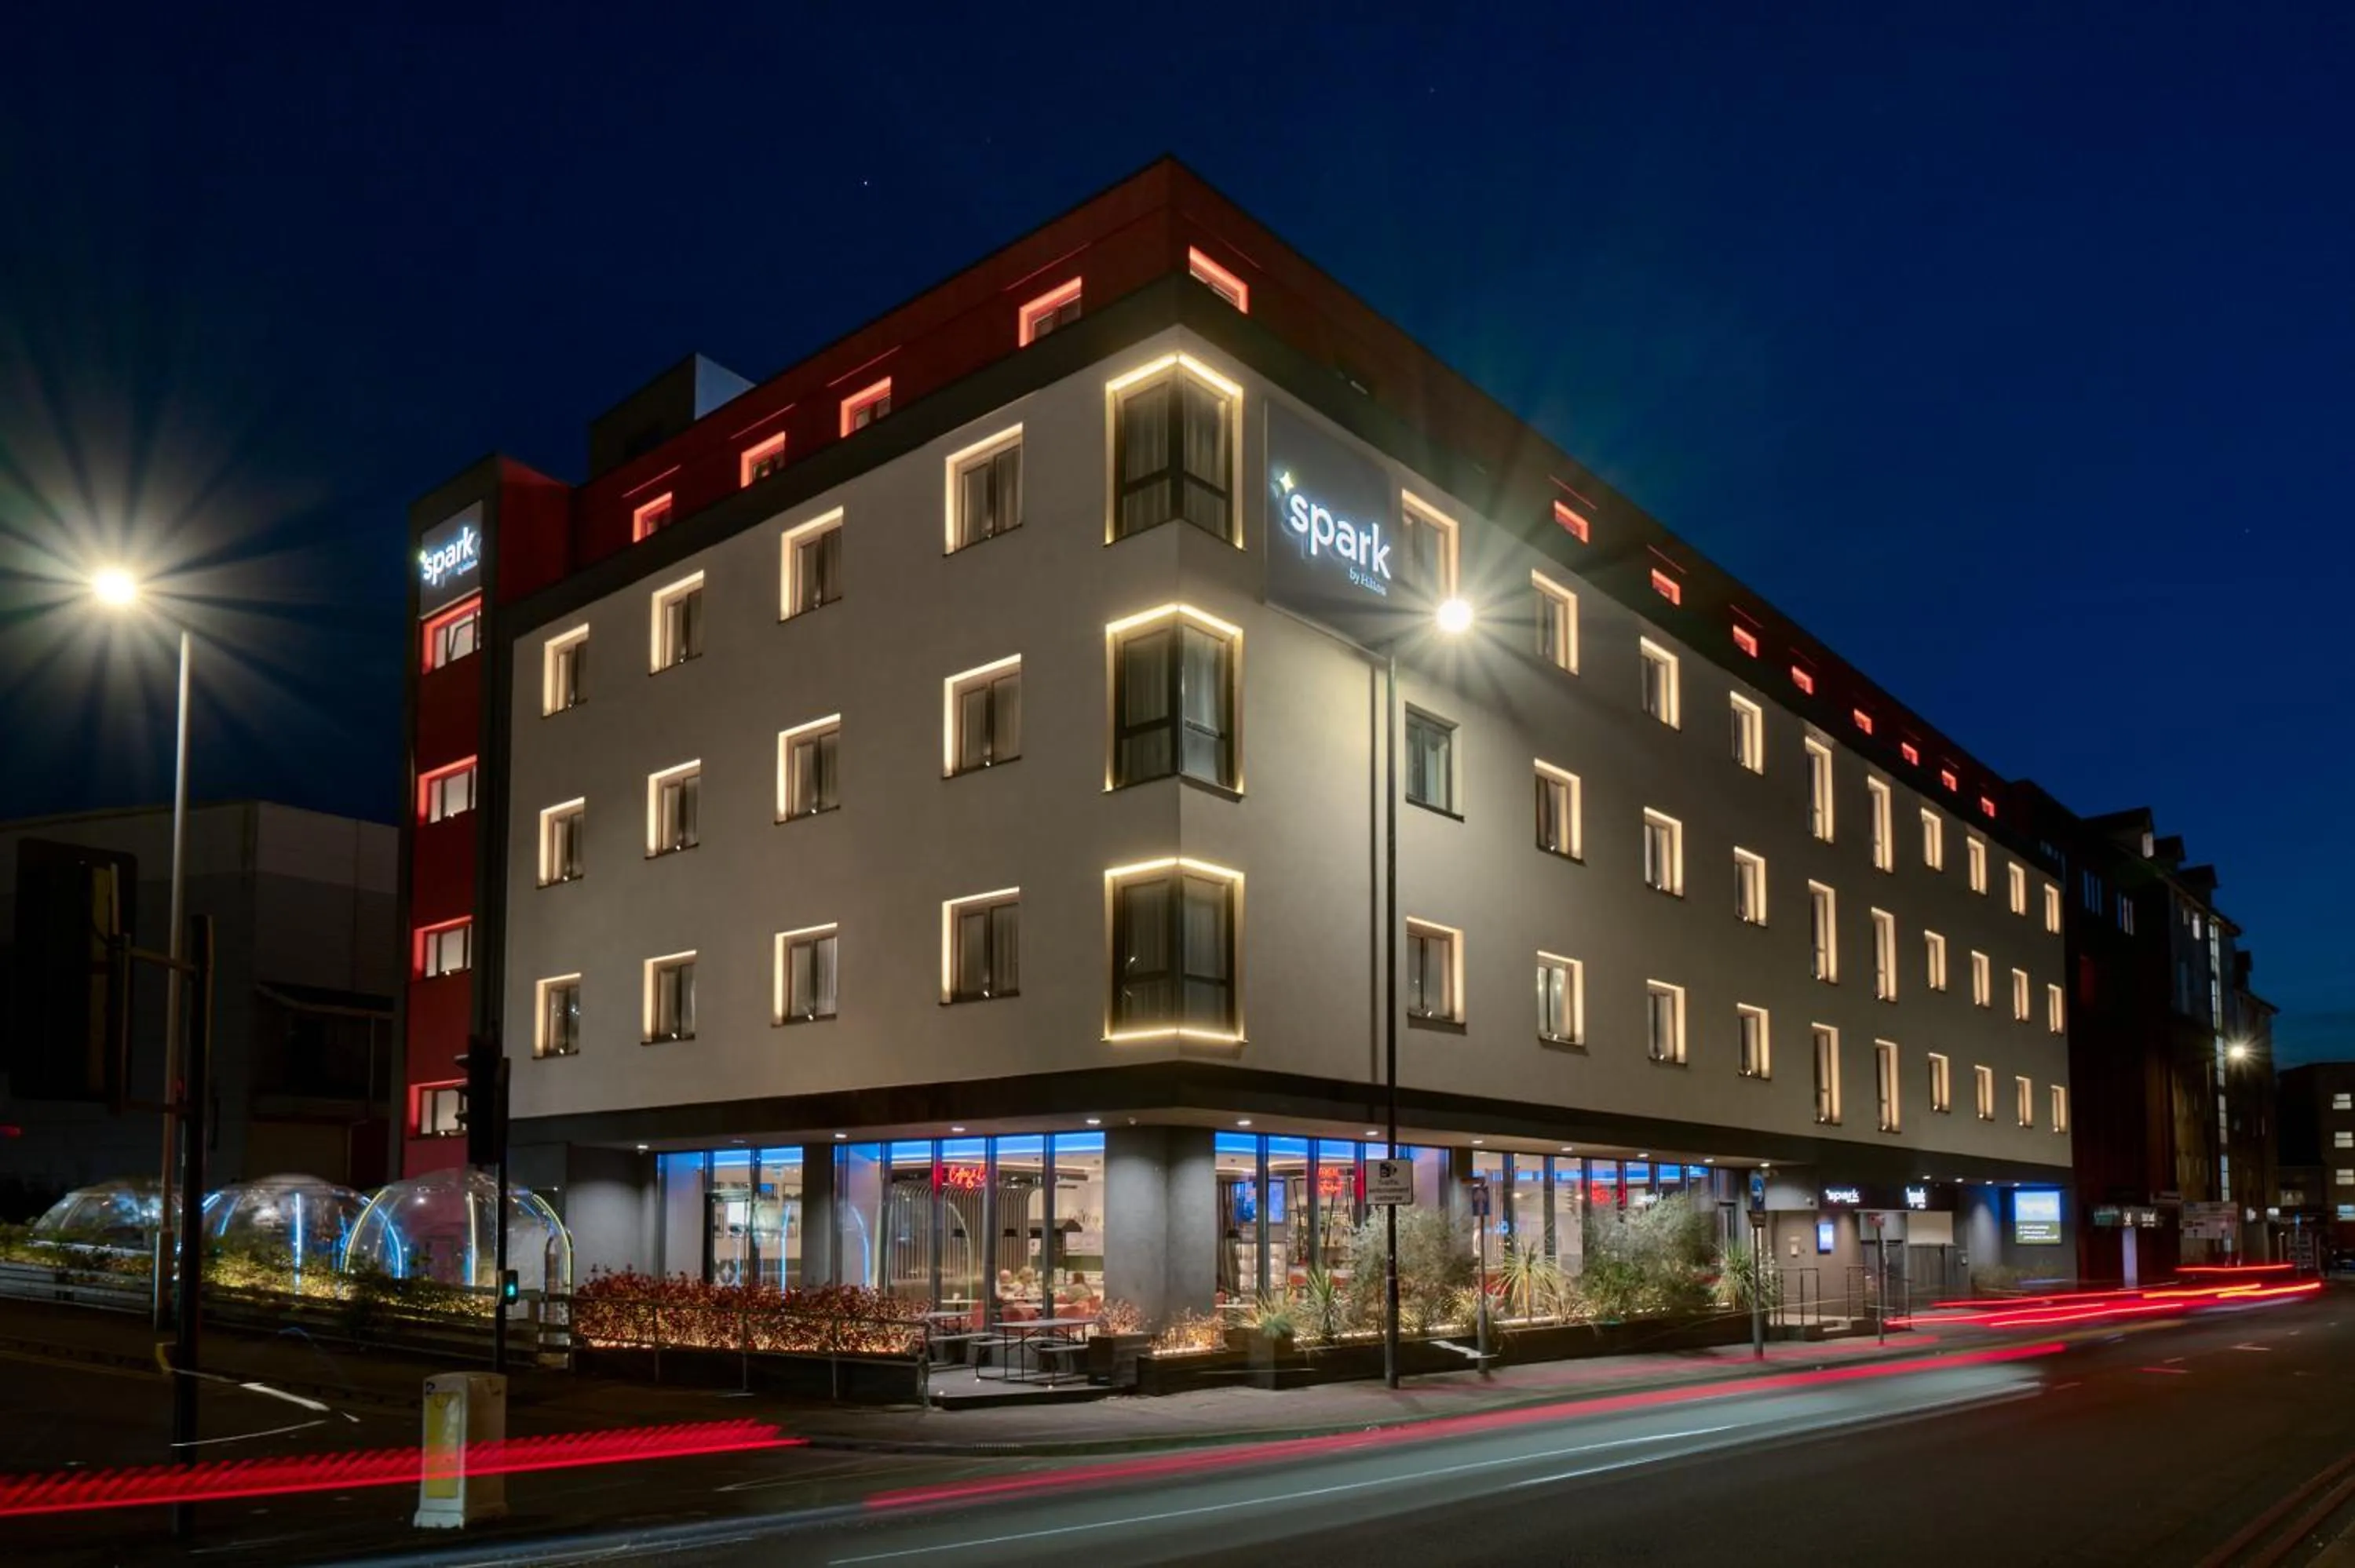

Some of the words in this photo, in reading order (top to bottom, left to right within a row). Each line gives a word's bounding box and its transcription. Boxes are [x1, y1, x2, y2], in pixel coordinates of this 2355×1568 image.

[423, 527, 476, 585] spark
[1290, 494, 1391, 580] spark
[1349, 566, 1360, 585] by
[1827, 1188, 1859, 1203] spark
